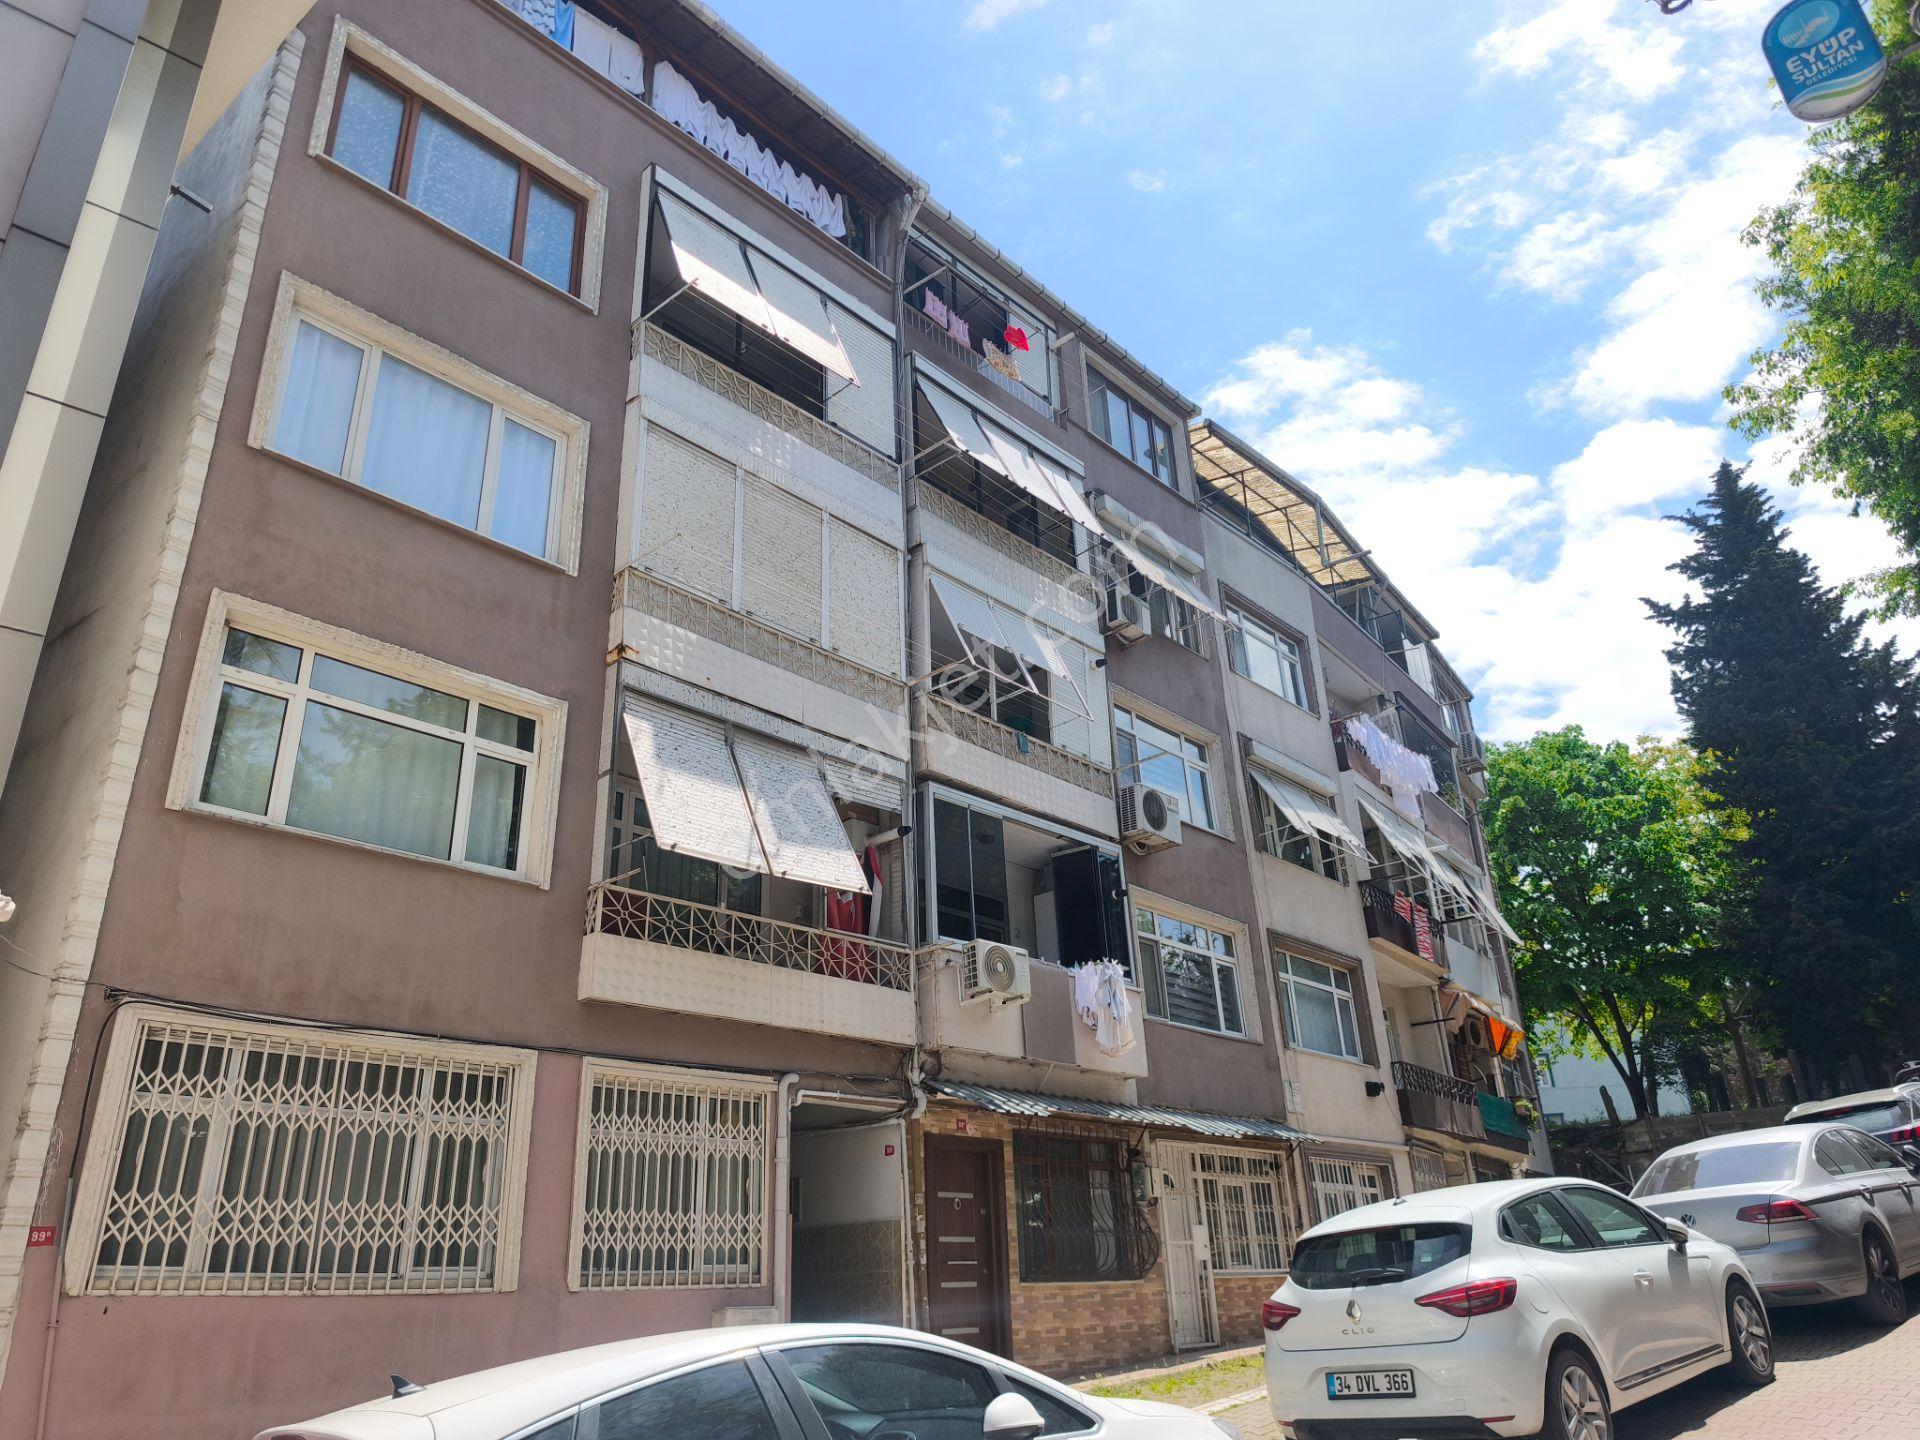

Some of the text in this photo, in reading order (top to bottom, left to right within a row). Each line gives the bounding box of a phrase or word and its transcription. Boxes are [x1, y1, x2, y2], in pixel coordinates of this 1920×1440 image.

[1785, 27, 1856, 74] EYÜP
[1791, 39, 1865, 85] SULTAN
[1342, 1327, 1376, 1335] CLIO
[1335, 1373, 1409, 1393] 34 DVL 366
